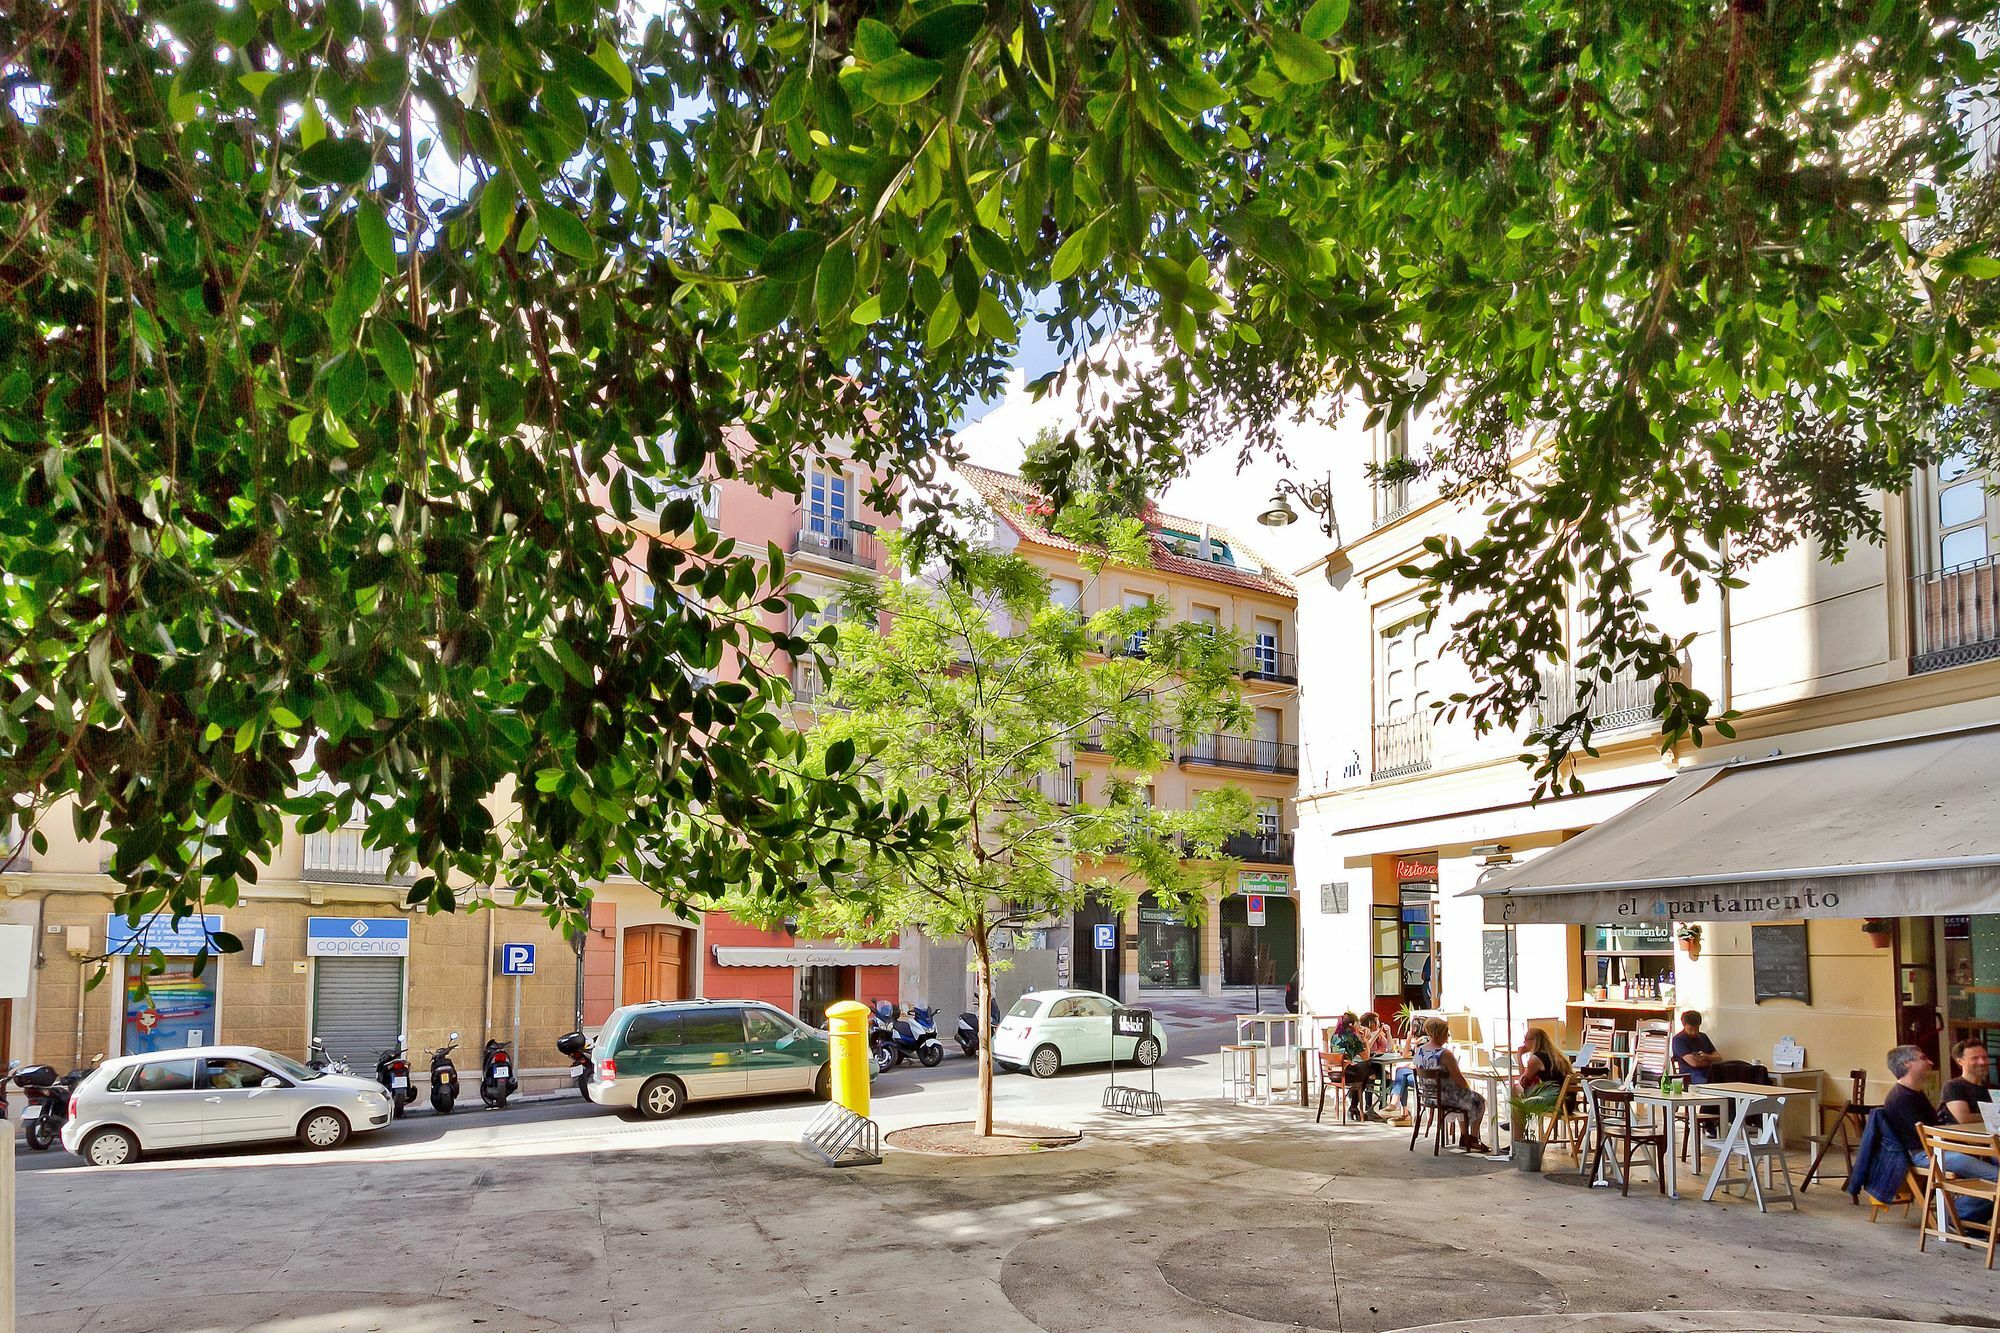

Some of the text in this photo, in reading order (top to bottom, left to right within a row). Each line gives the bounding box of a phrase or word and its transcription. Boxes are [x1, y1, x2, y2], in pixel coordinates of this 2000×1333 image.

[1396, 860, 1438, 878] Ristora
[1617, 887, 1840, 919] el apartamento
[1099, 927, 1110, 946] P
[317, 939, 400, 954] copicentro
[509, 947, 528, 971] P
